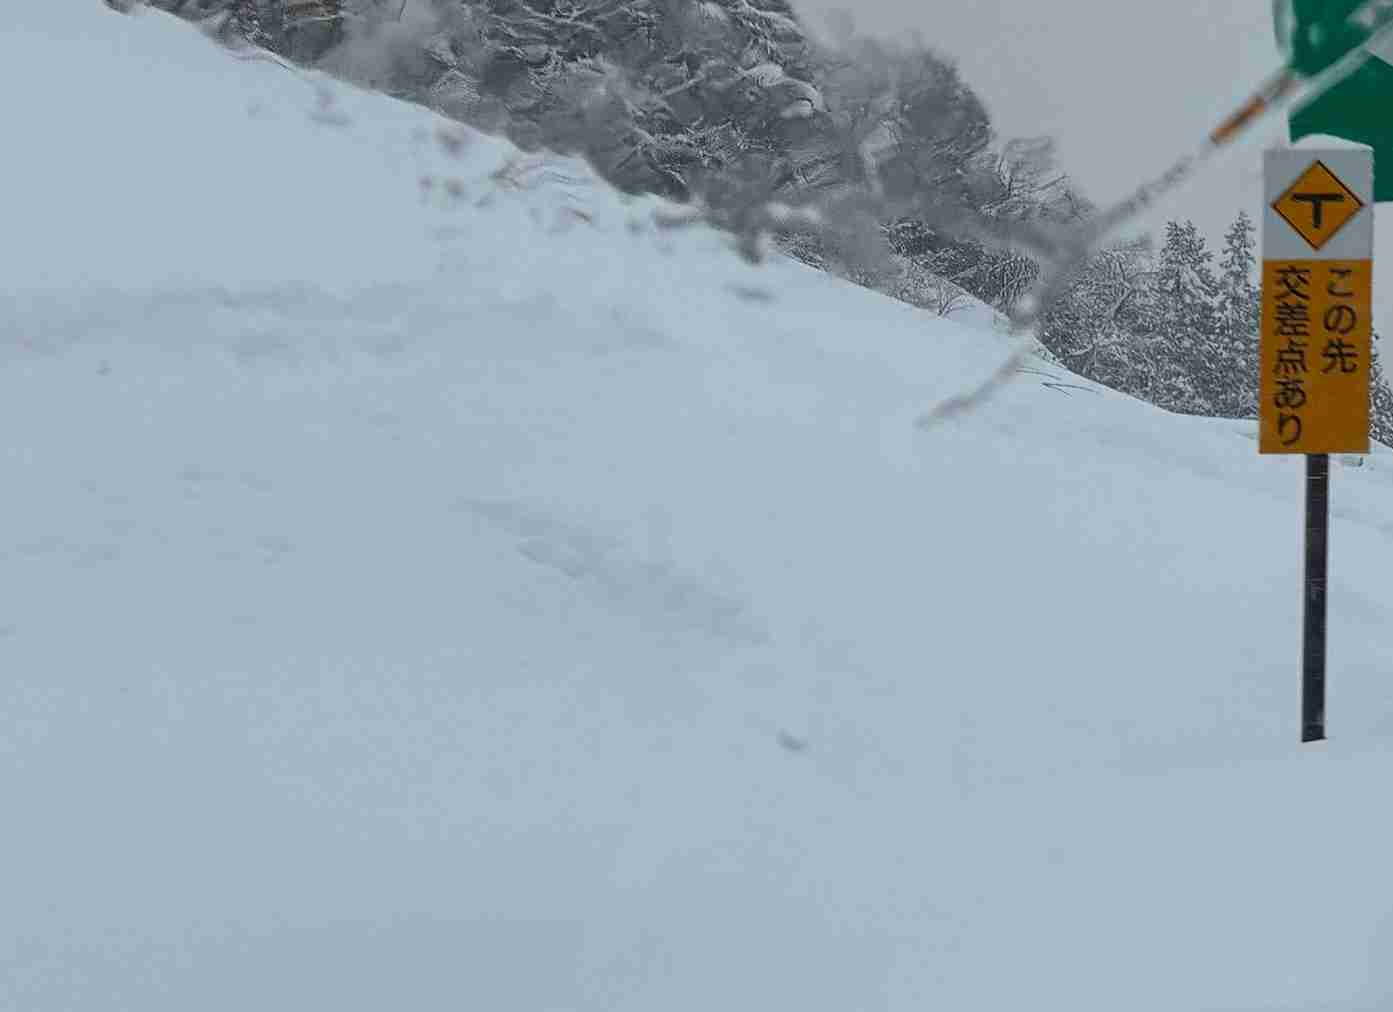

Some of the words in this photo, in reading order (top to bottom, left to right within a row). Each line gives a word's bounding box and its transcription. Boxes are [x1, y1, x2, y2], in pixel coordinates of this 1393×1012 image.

[1273, 264, 1312, 447] 交差点あり
[1319, 265, 1359, 375] この先
